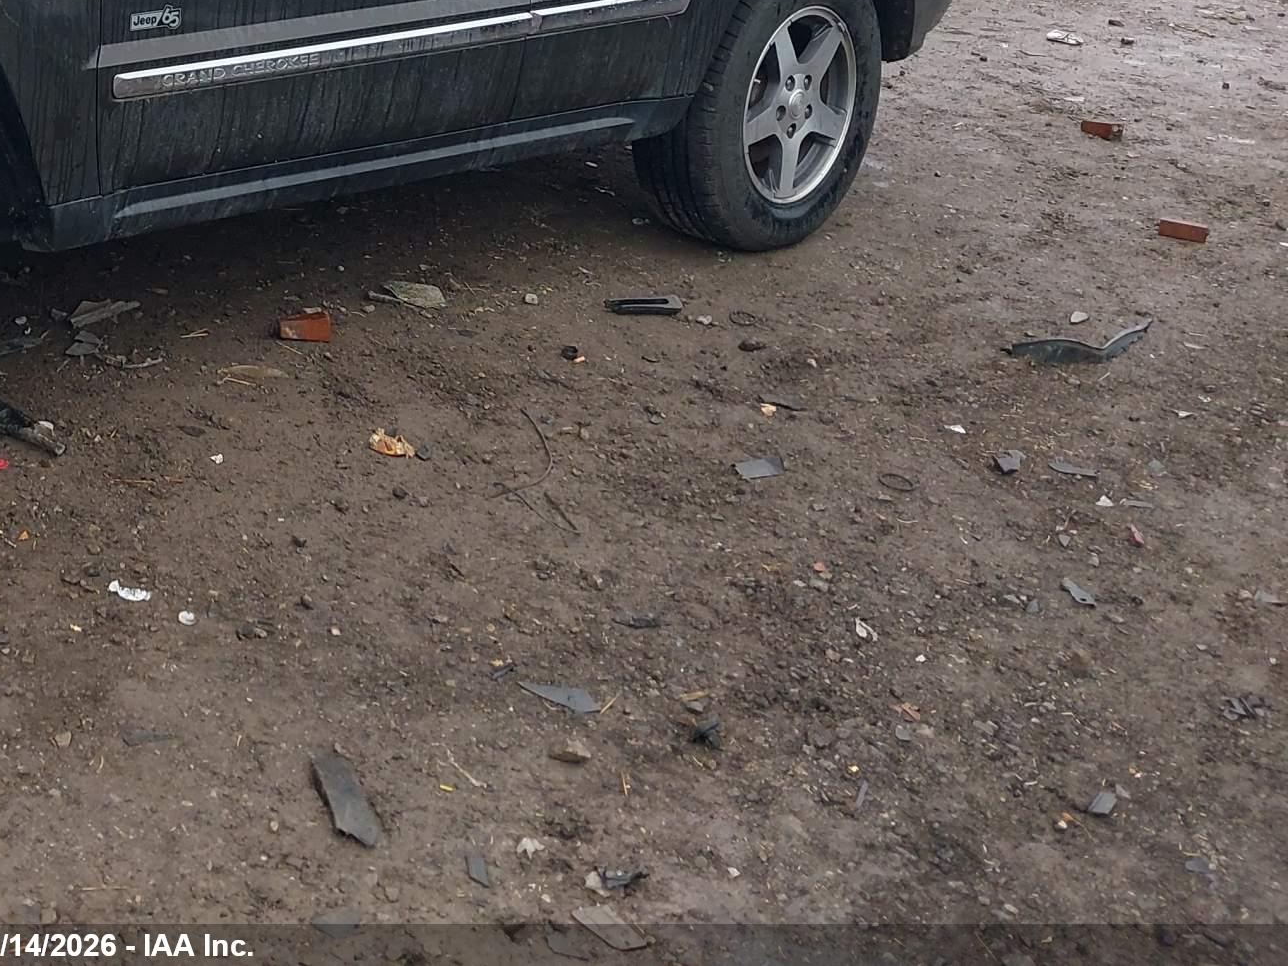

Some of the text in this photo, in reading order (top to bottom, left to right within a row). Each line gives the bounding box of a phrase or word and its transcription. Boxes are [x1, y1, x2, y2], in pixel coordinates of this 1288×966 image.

[133, 7, 180, 27] Jeep 65
[162, 52, 321, 88] GRAND CHEROKEE
